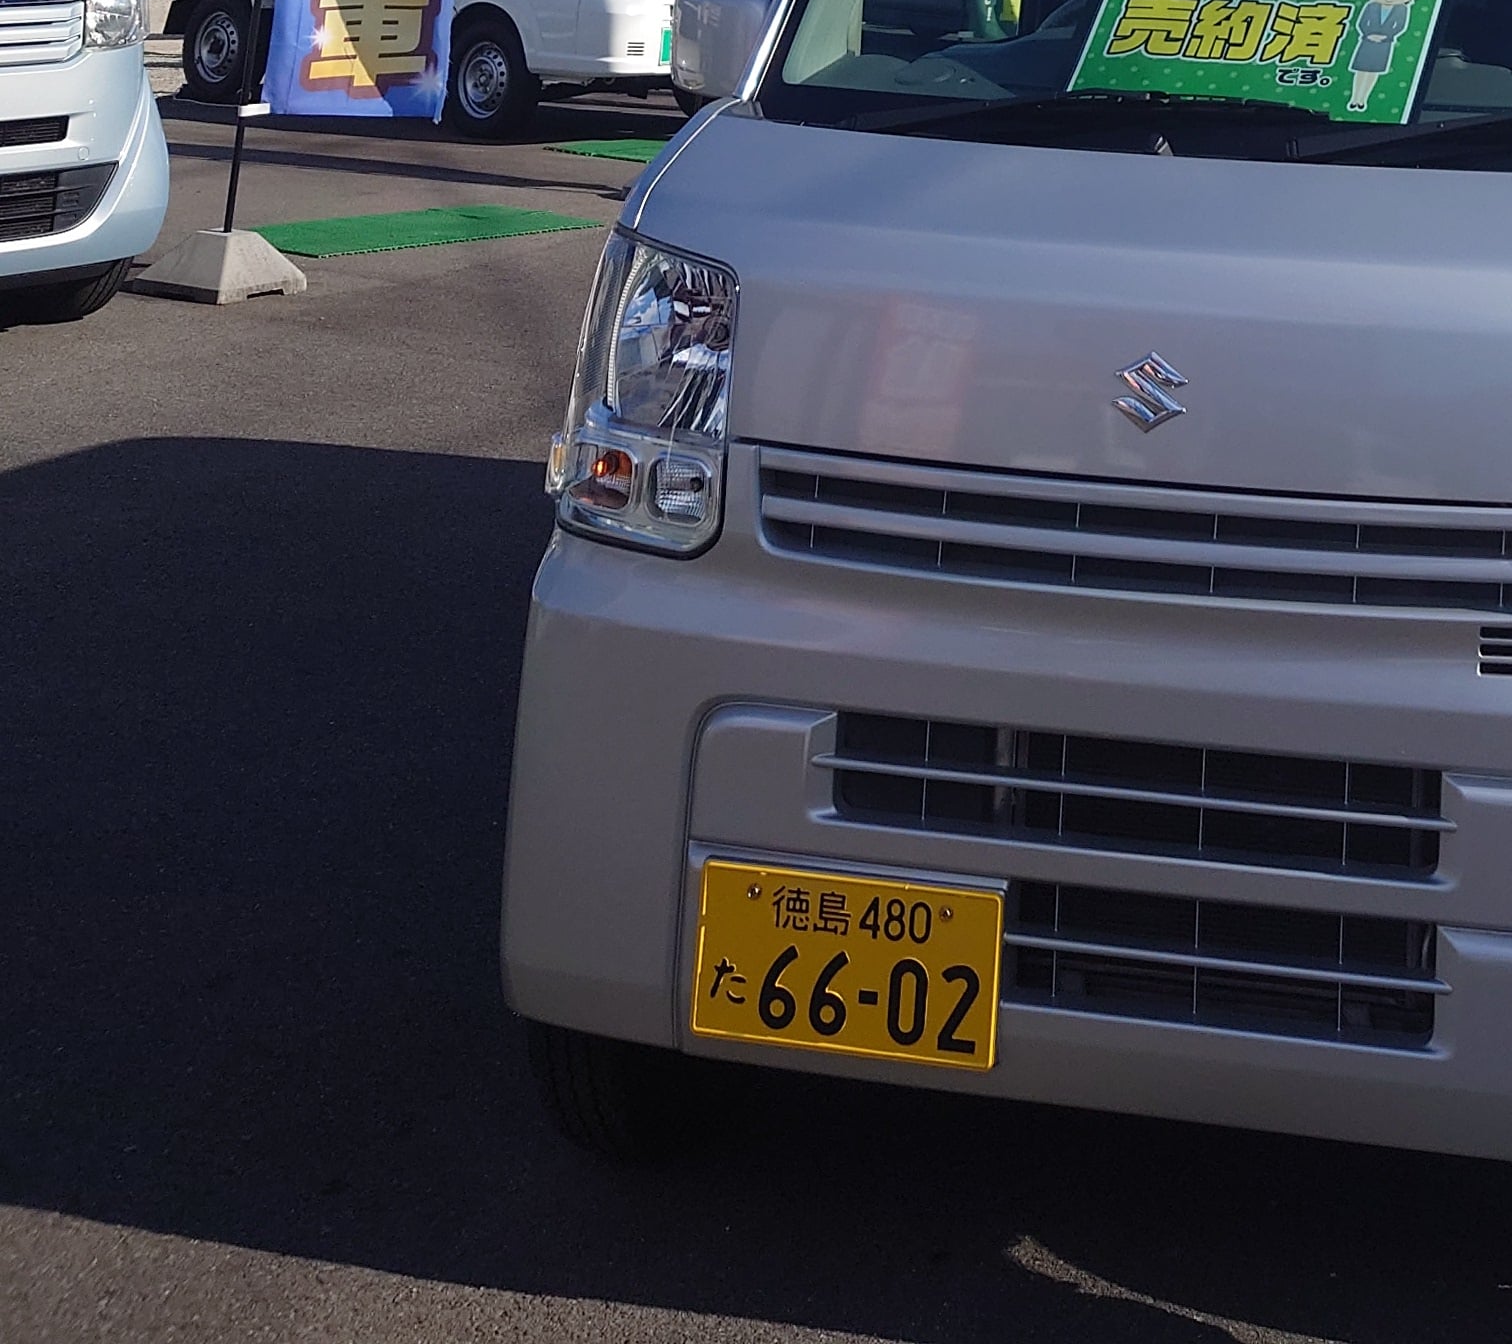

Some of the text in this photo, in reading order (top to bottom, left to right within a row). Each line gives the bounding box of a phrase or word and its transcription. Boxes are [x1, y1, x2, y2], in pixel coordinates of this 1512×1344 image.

[1278, 68, 1331, 87] です。
[772, 885, 932, 944] 徳島 480
[710, 944, 981, 1055] た 66-02
